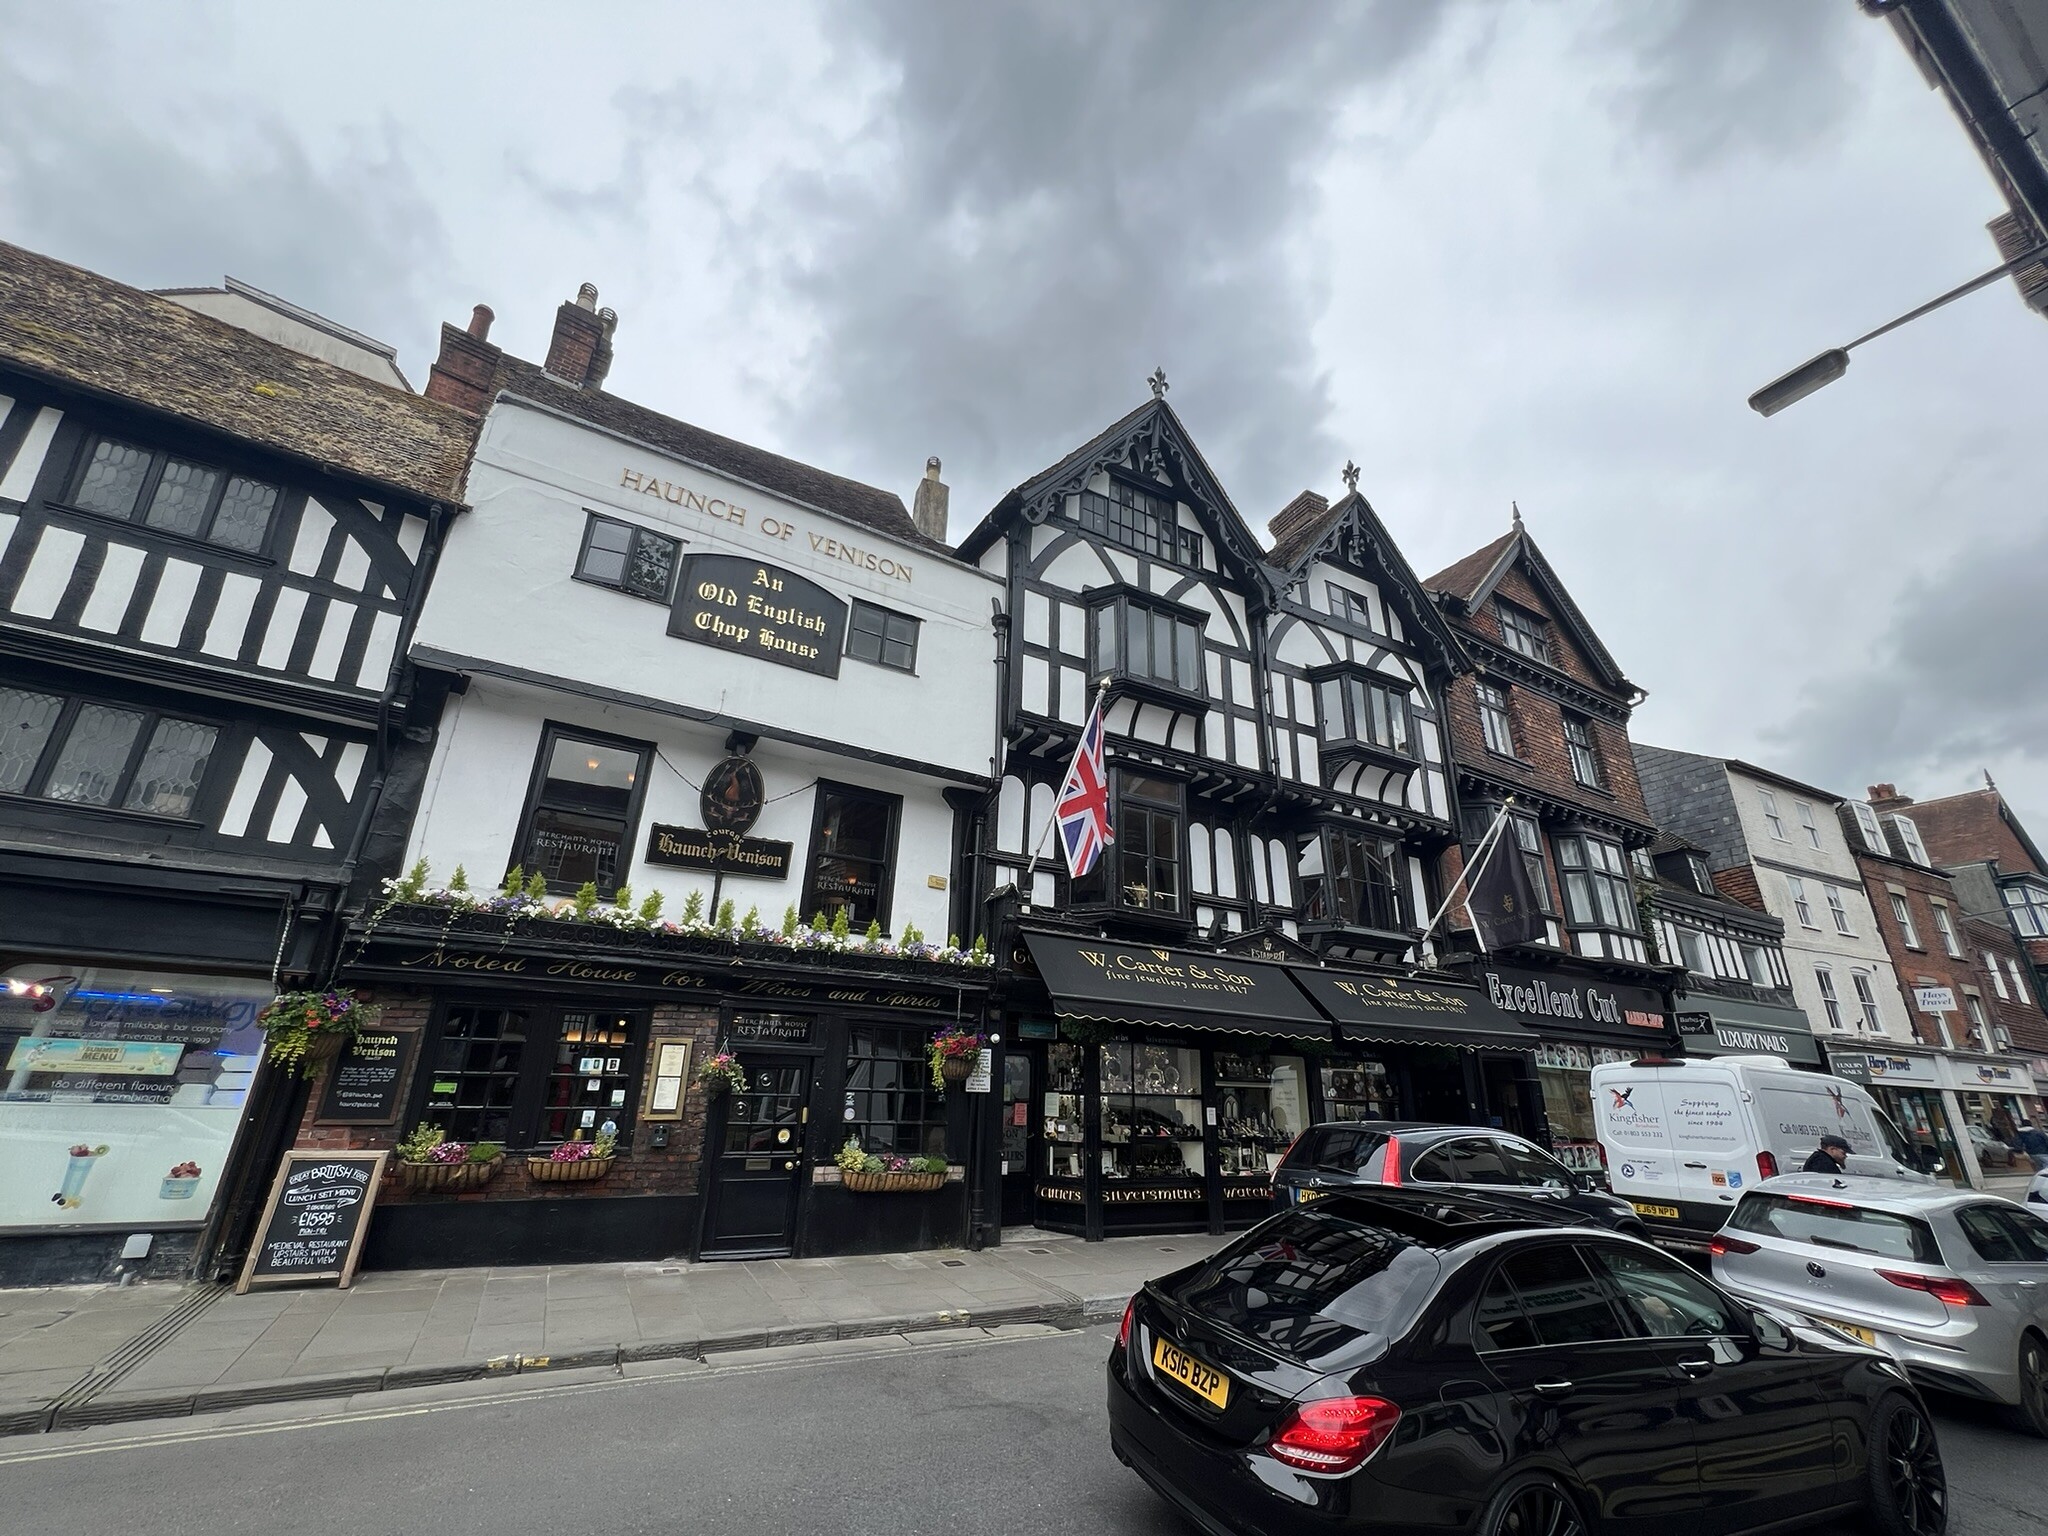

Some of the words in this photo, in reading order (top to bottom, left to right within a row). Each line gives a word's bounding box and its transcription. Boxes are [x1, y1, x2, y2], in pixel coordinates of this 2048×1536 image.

[620, 468, 746, 526] HAUNCH
[760, 515, 795, 541] OF
[808, 531, 913, 583] VENISON
[752, 569, 784, 593] An
[698, 581, 738, 608] Old
[748, 595, 826, 637] English
[695, 611, 750, 643] Chop
[759, 628, 820, 661] House
[659, 833, 717, 863] Haunch
[726, 843, 782, 867] Venison
[401, 950, 528, 974] Noted
[547, 961, 637, 982] House
[662, 970, 707, 988] for
[738, 980, 813, 998] Wines
[828, 989, 871, 1002] and
[876, 990, 941, 1009] Spirits
[1116, 955, 1185, 977] Carter
[1189, 964, 1214, 980] &
[1213, 967, 1256, 986] Son
[1105, 970, 1131, 981] fine
[1135, 973, 1188, 989] jewellery
[1191, 982, 1220, 991] since
[1222, 984, 1248, 994] 1817
[1362, 983, 1414, 1002] Carter
[1414, 989, 1437, 1003] &
[1433, 991, 1468, 1007] Son
[1486, 972, 1584, 1019] Excellent
[1587, 988, 1621, 1024] Cut
[1922, 992, 1947, 1000] Hays
[123, 1021, 170, 1031] milkshake
[173, 1023, 188, 1032] bar
[737, 1026, 807, 1038] RESTAURANT
[352, 1046, 396, 1057] Venison
[1717, 1030, 1757, 1050] LUXURY
[1756, 1034, 1789, 1053] NAILS
[1867, 1055, 1887, 1071] Hays
[1886, 1057, 1912, 1072] Travel
[74, 1078, 125, 1091] different
[130, 1080, 175, 1092] flavours
[1609, 1112, 1659, 1126] Kingfisher
[289, 1170, 310, 1184] GREAT
[311, 1164, 354, 1179] BRITISH
[353, 1169, 368, 1182] FOOD
[288, 1192, 317, 1203] LUNCH
[318, 1191, 333, 1199] SET
[334, 1188, 357, 1197] MENU
[1636, 1204, 1657, 1215] EJ69
[1658, 1207, 1675, 1216] NPD
[268, 1241, 306, 1250] MEDIEVAL
[308, 1240, 349, 1249] RESTAURANT
[273, 1249, 309, 1258] UPSTAIRS
[311, 1248, 330, 1256] WITH
[270, 1257, 315, 1267] BEAUTIFUL
[317, 1256, 337, 1265] VIEW
[1161, 1344, 1190, 1380] KS16
[1191, 1364, 1220, 1396] BZP
